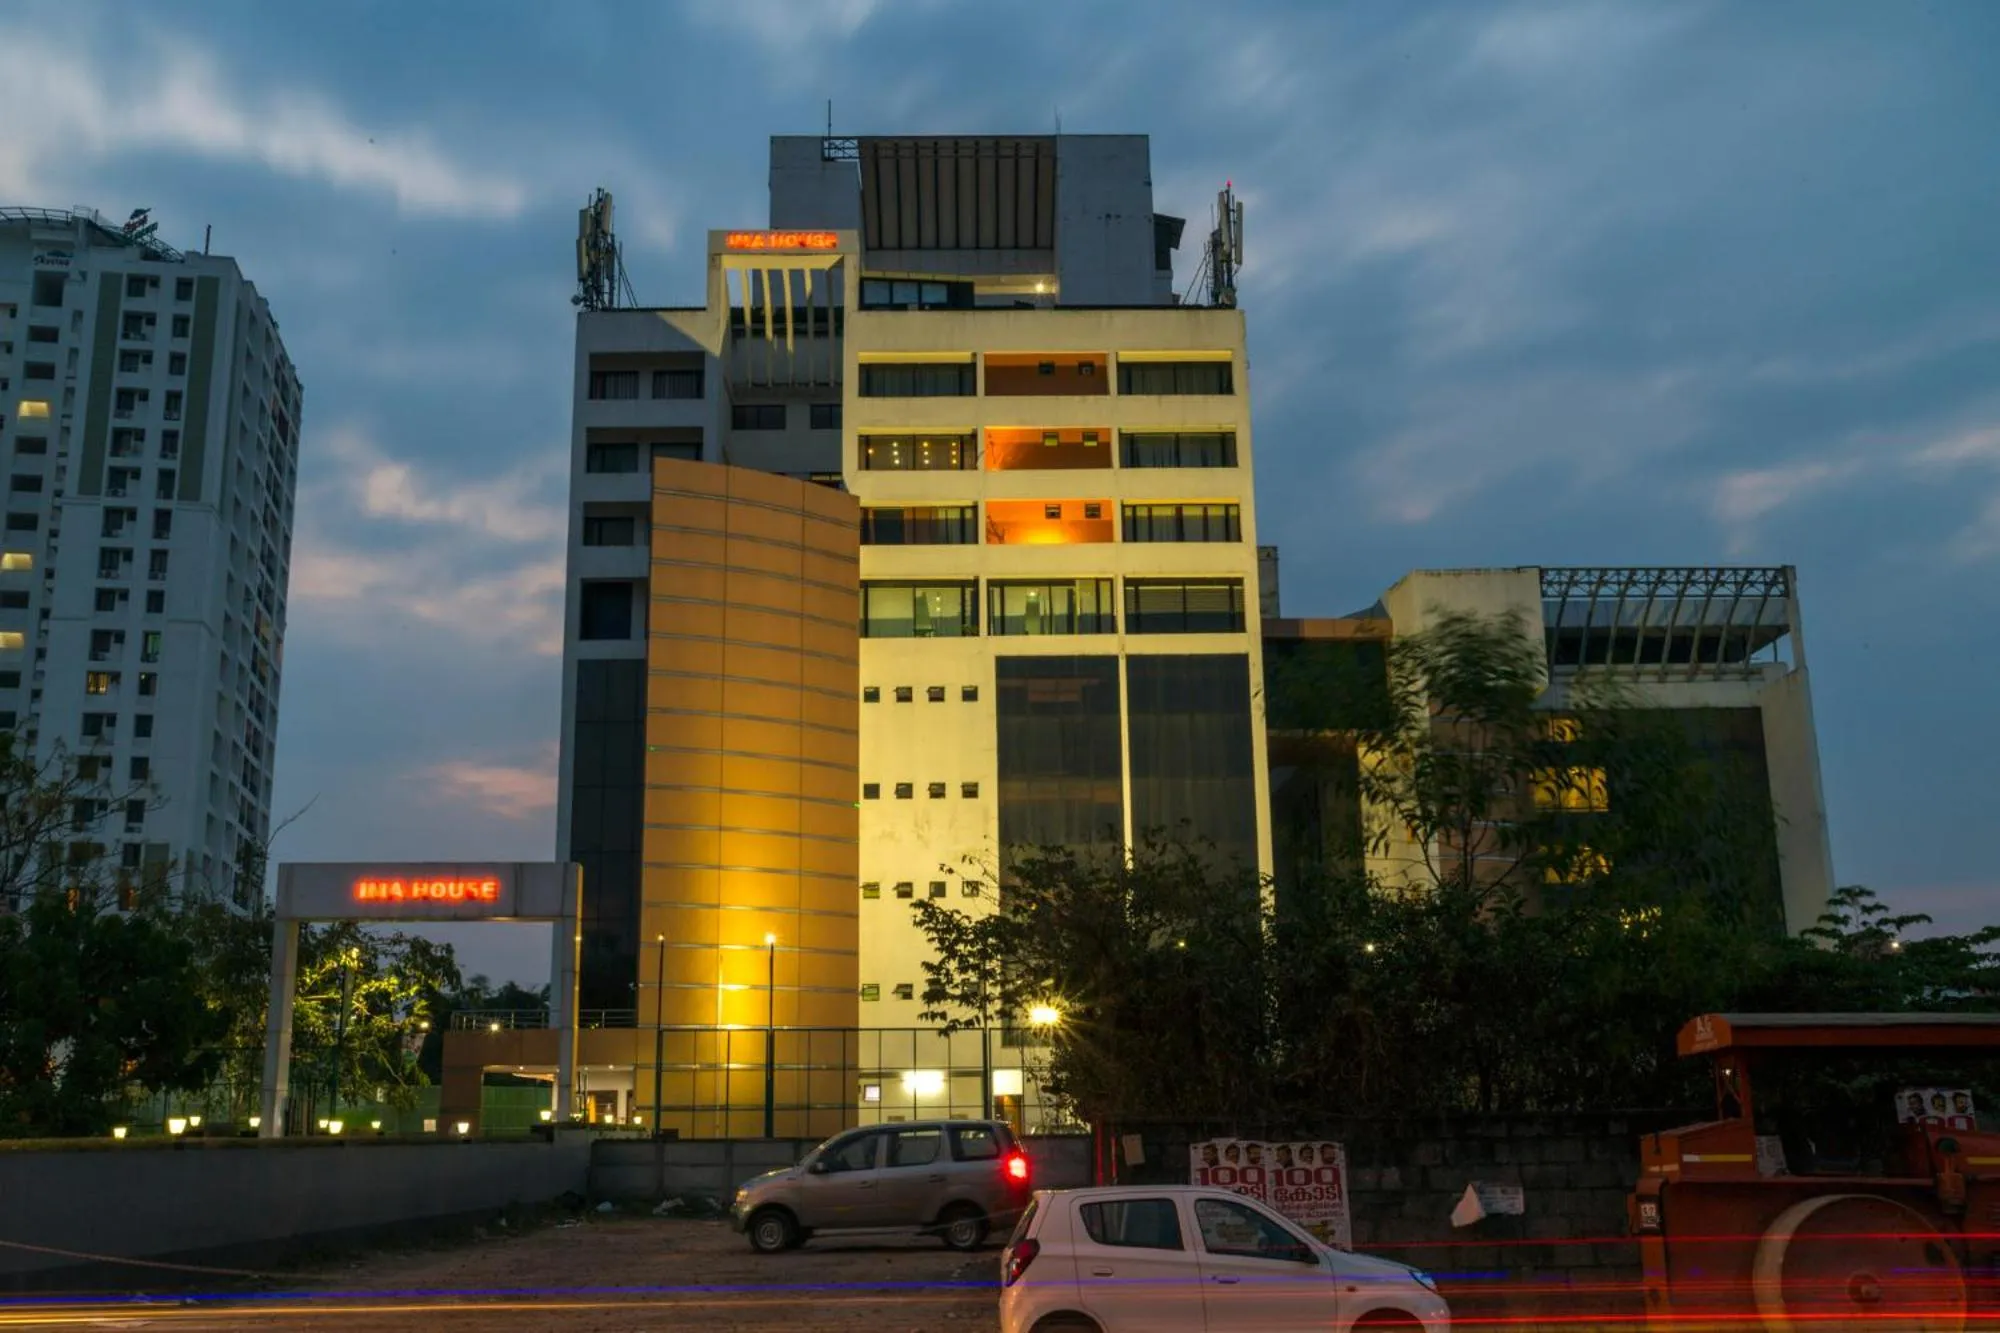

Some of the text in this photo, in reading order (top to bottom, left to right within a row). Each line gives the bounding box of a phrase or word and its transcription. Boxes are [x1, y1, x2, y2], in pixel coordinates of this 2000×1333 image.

[412, 881, 497, 899] HOUSE
[1196, 1166, 1265, 1186] 100
[1270, 1166, 1341, 1186] 100
